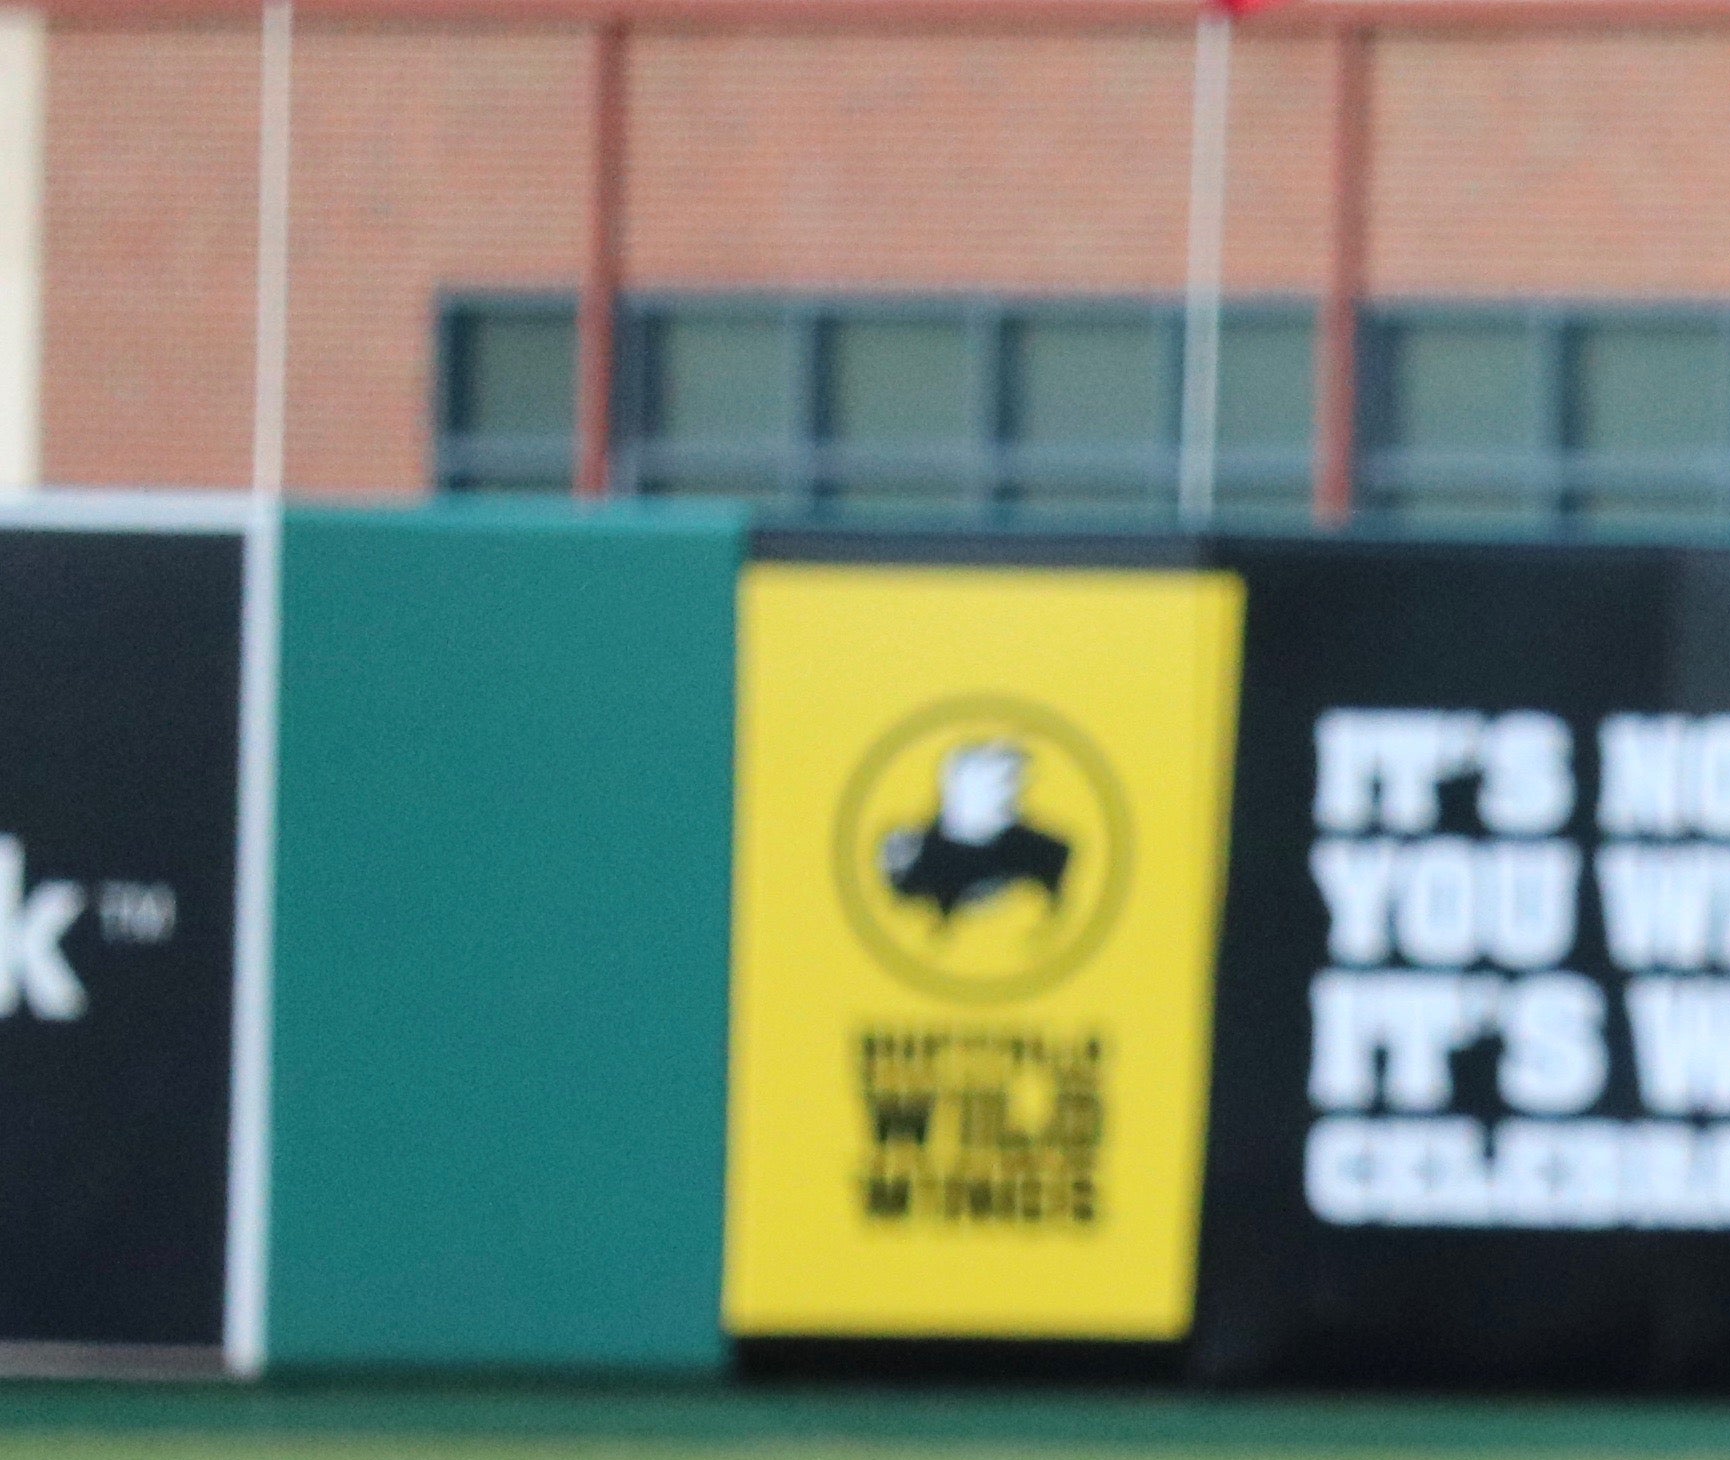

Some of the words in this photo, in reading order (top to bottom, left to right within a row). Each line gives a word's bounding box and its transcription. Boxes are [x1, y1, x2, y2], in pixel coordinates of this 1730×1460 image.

[1313, 709, 1573, 836] IT'S
[1309, 837, 1582, 966] YOU
[1309, 968, 1607, 1114] IT'S
